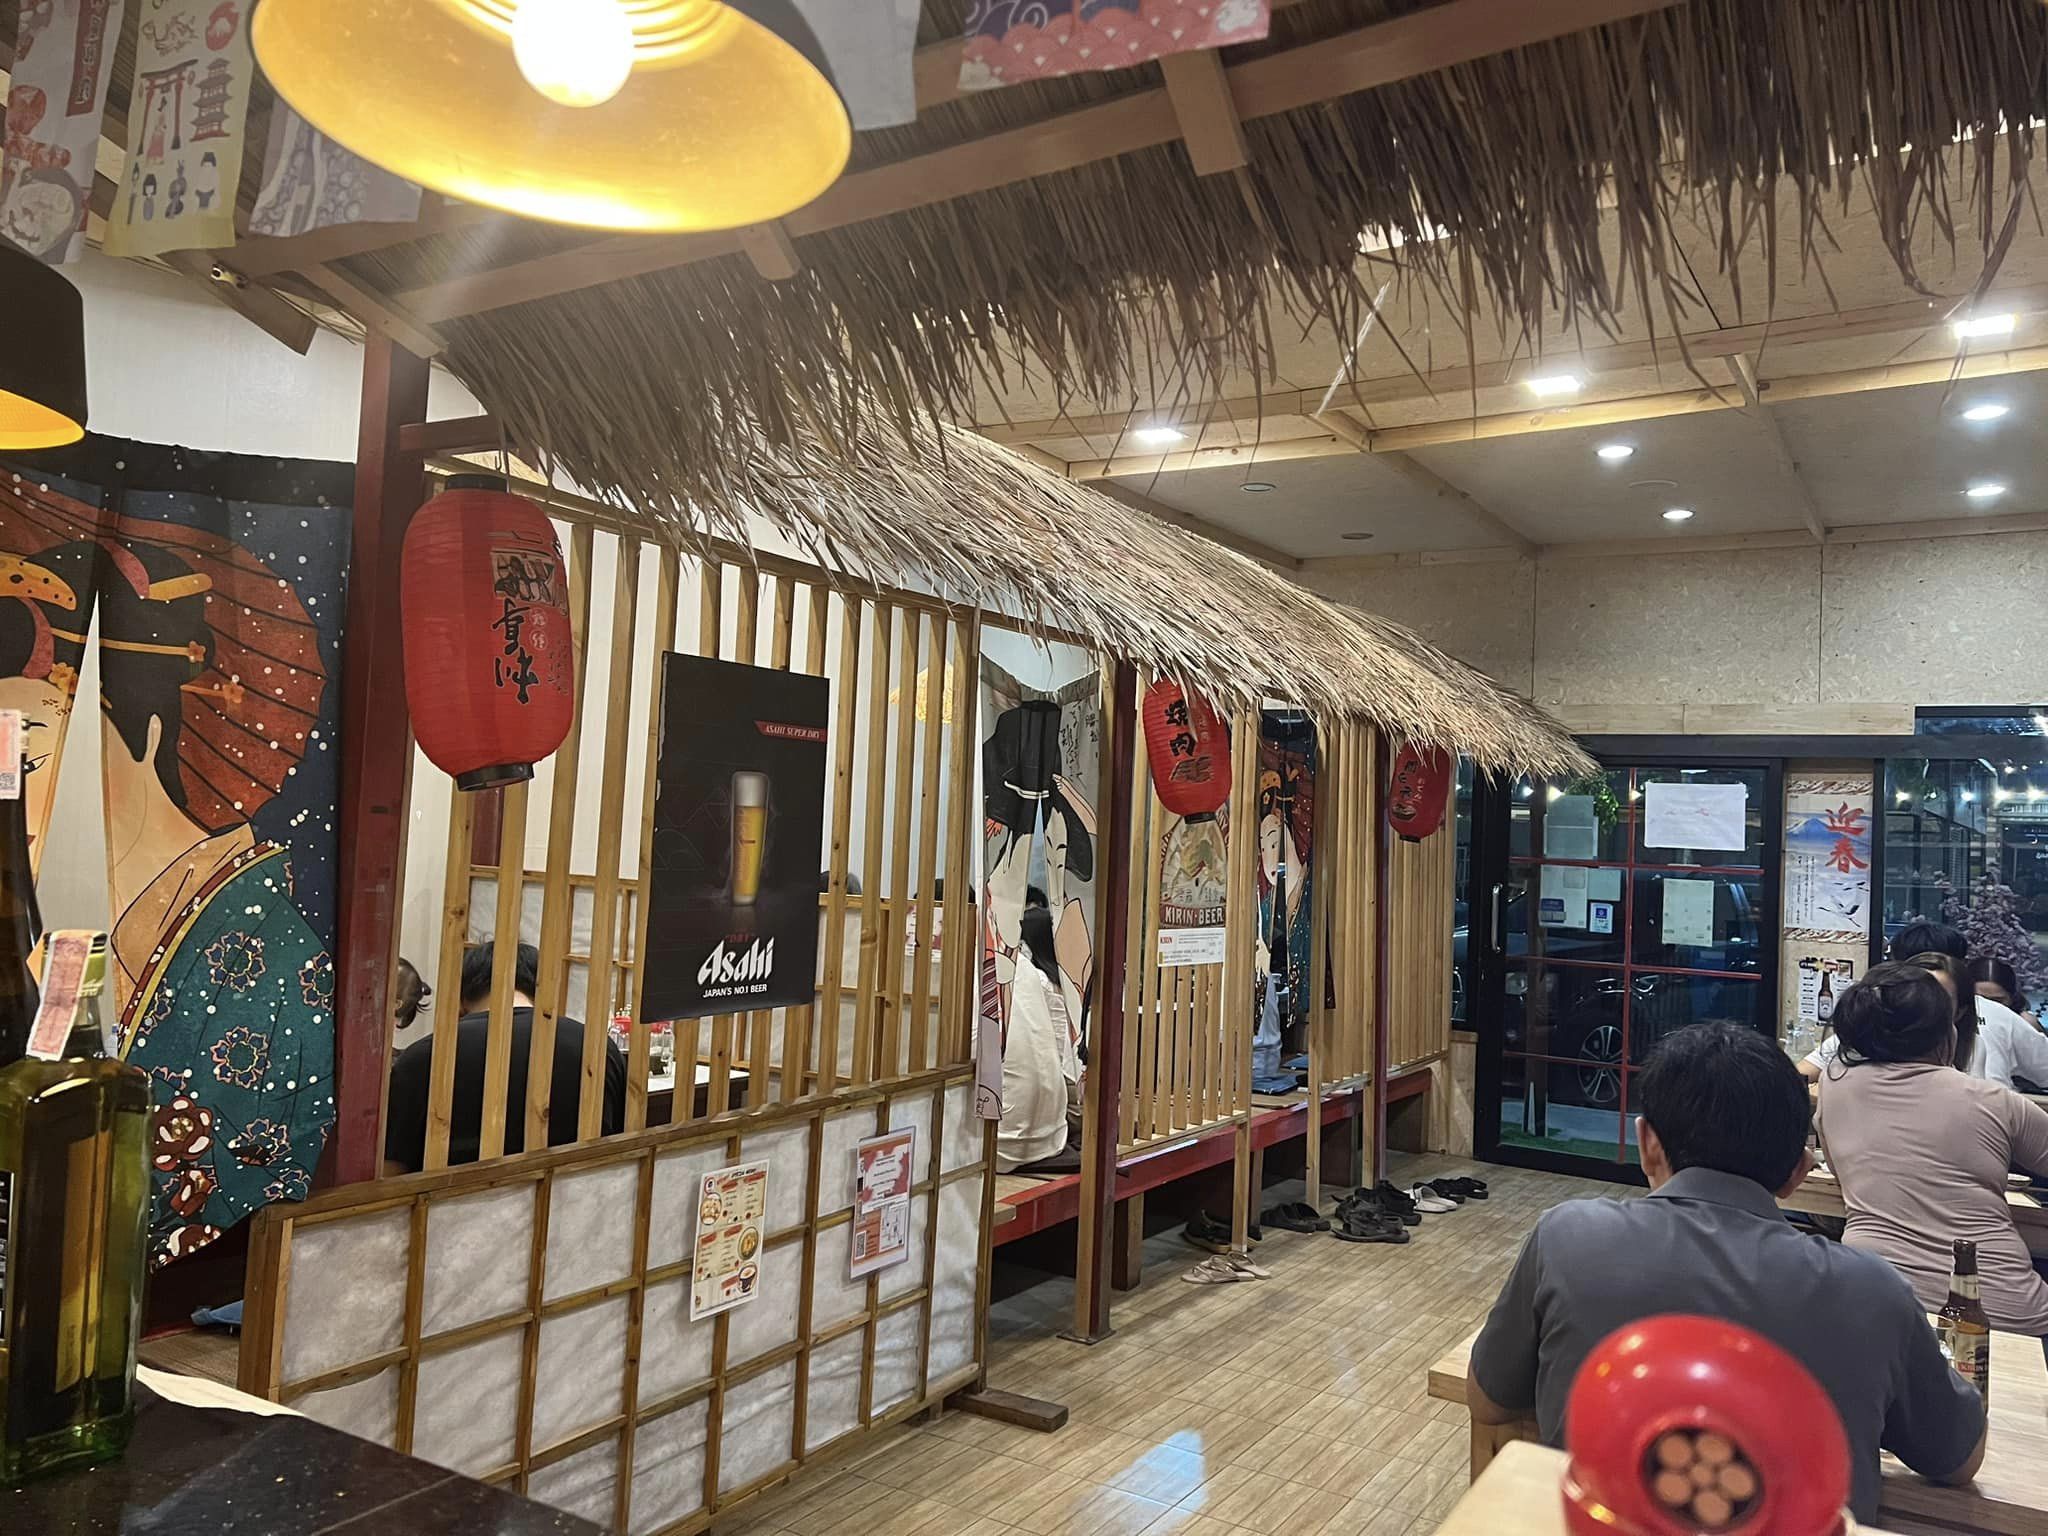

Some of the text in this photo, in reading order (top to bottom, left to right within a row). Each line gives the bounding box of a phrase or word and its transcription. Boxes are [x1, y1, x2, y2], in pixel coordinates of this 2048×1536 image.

[1825, 800, 1869, 874] 迎春
[1165, 905, 1223, 925] KIRIN BEER
[697, 936, 775, 986] Asahi
[703, 984, 768, 998] JAPAN'S NO.1 BEER
